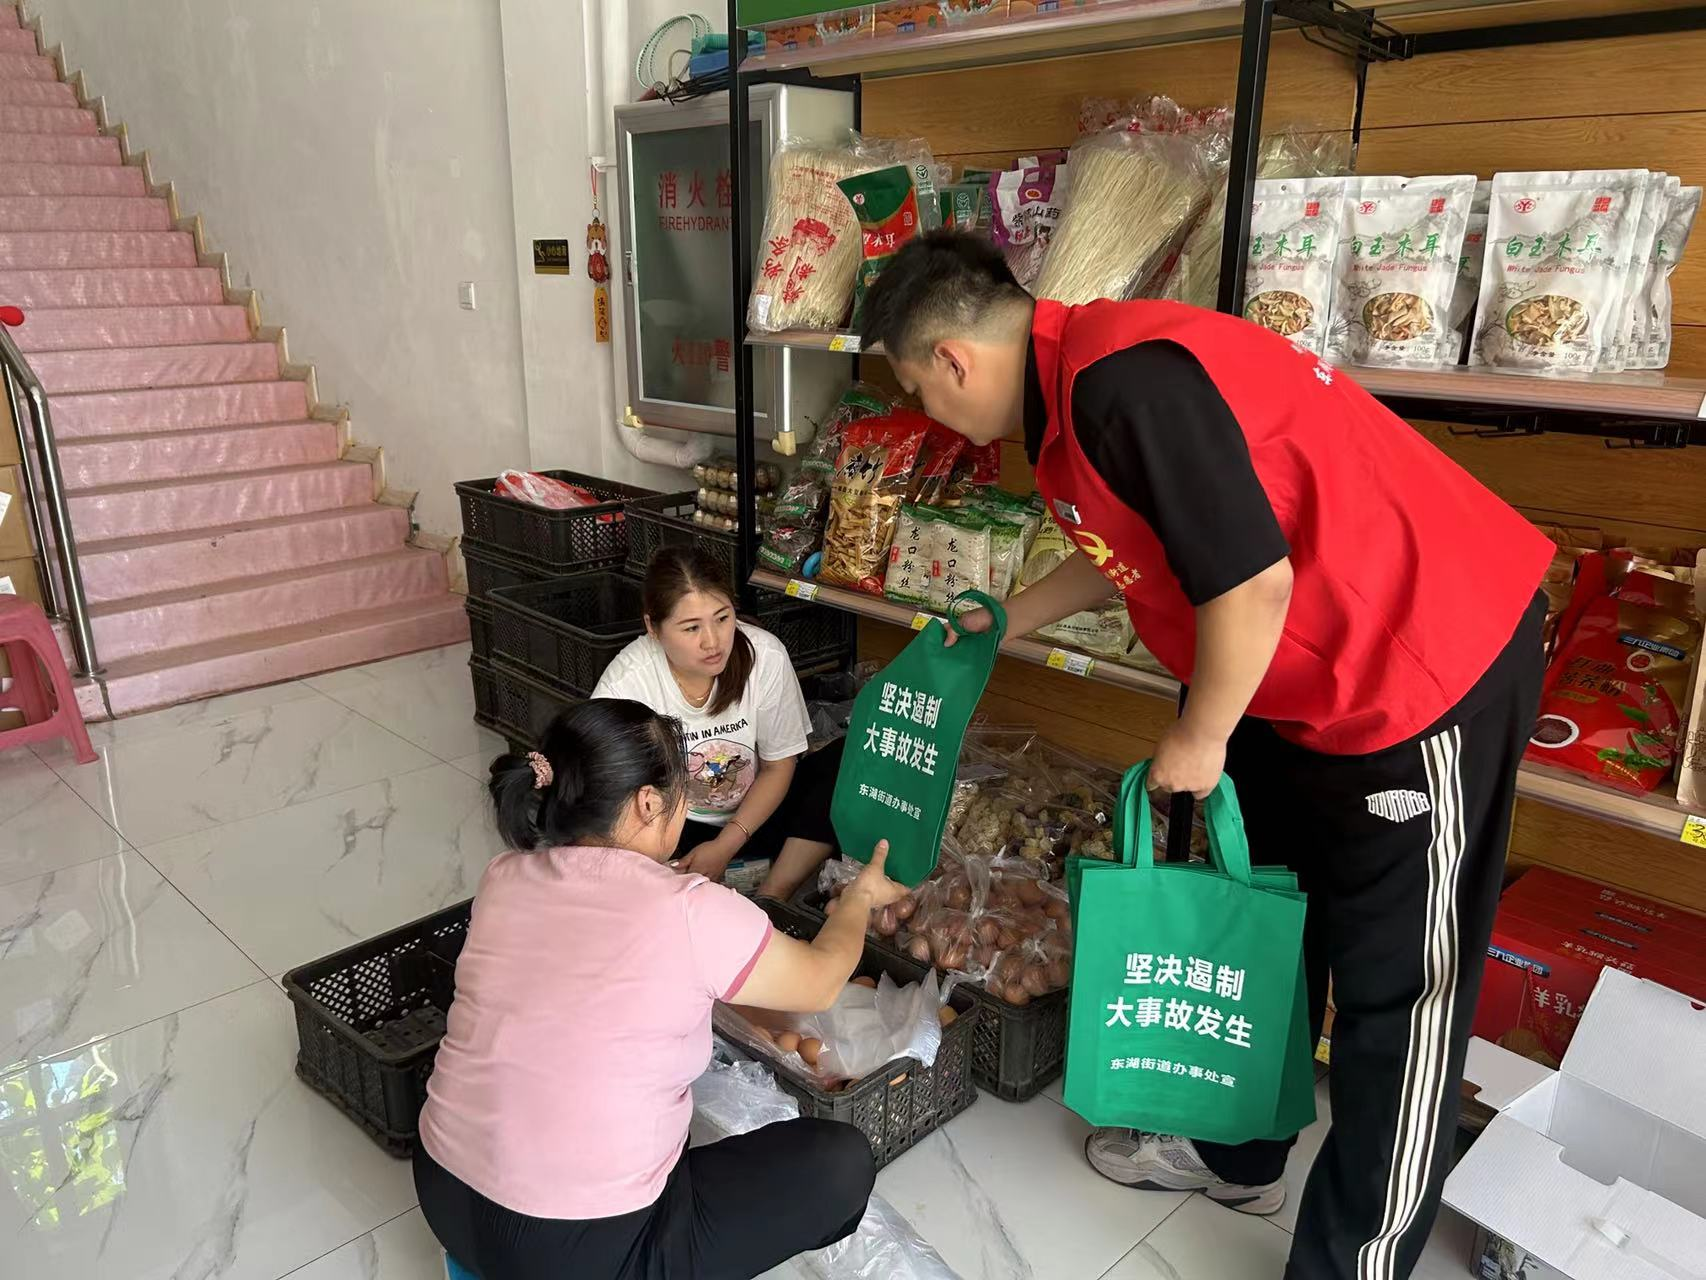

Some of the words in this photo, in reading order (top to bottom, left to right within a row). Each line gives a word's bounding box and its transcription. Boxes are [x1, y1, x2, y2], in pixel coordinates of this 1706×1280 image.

[658, 168, 733, 210] 消火栓
[1352, 232, 1440, 258] 白玉木耳
[1398, 264, 1428, 272] Fungus
[1505, 232, 1602, 262] 白玉木耳
[898, 526, 921, 589] 龙口粉丝
[944, 537, 959, 604] 龙口粉丝
[878, 681, 943, 729] 坚决遏制
[701, 728, 712, 739] IN
[863, 722, 939, 776] 大事故发生
[1123, 952, 1246, 1002] 坚决遏制
[1105, 996, 1253, 1049] 大事故发生
